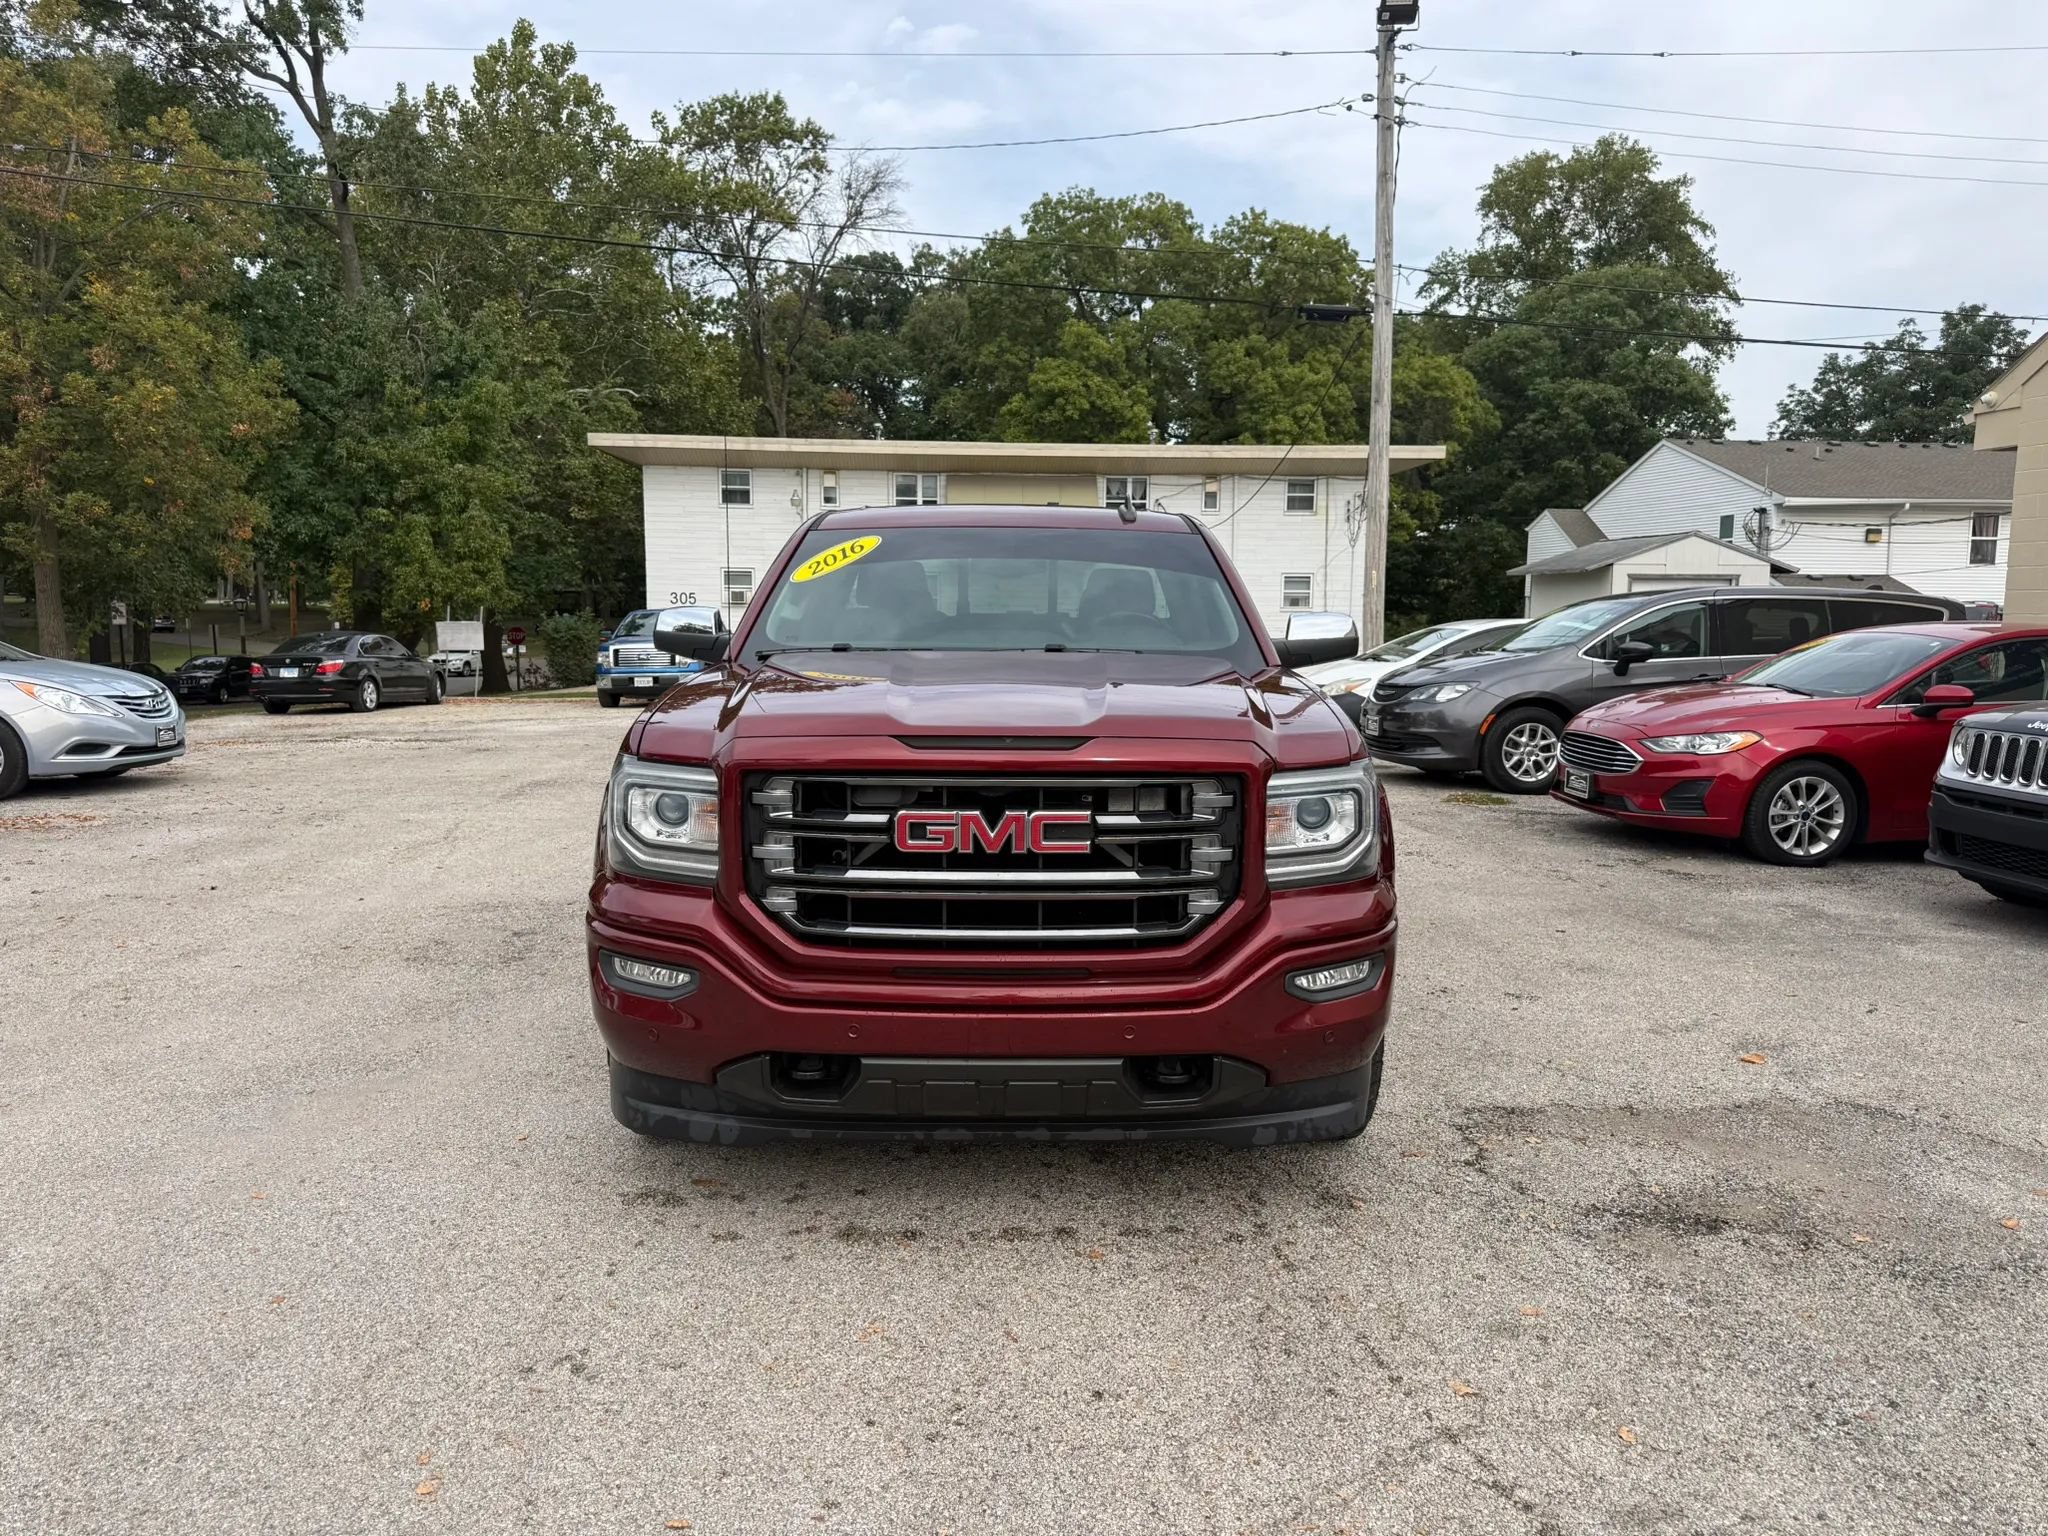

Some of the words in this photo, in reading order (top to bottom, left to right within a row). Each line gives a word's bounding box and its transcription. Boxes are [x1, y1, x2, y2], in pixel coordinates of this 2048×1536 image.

[808, 540, 864, 575] 2016
[670, 592, 696, 604] 305
[508, 632, 525, 640] STOP
[895, 809, 1091, 853] GMC
